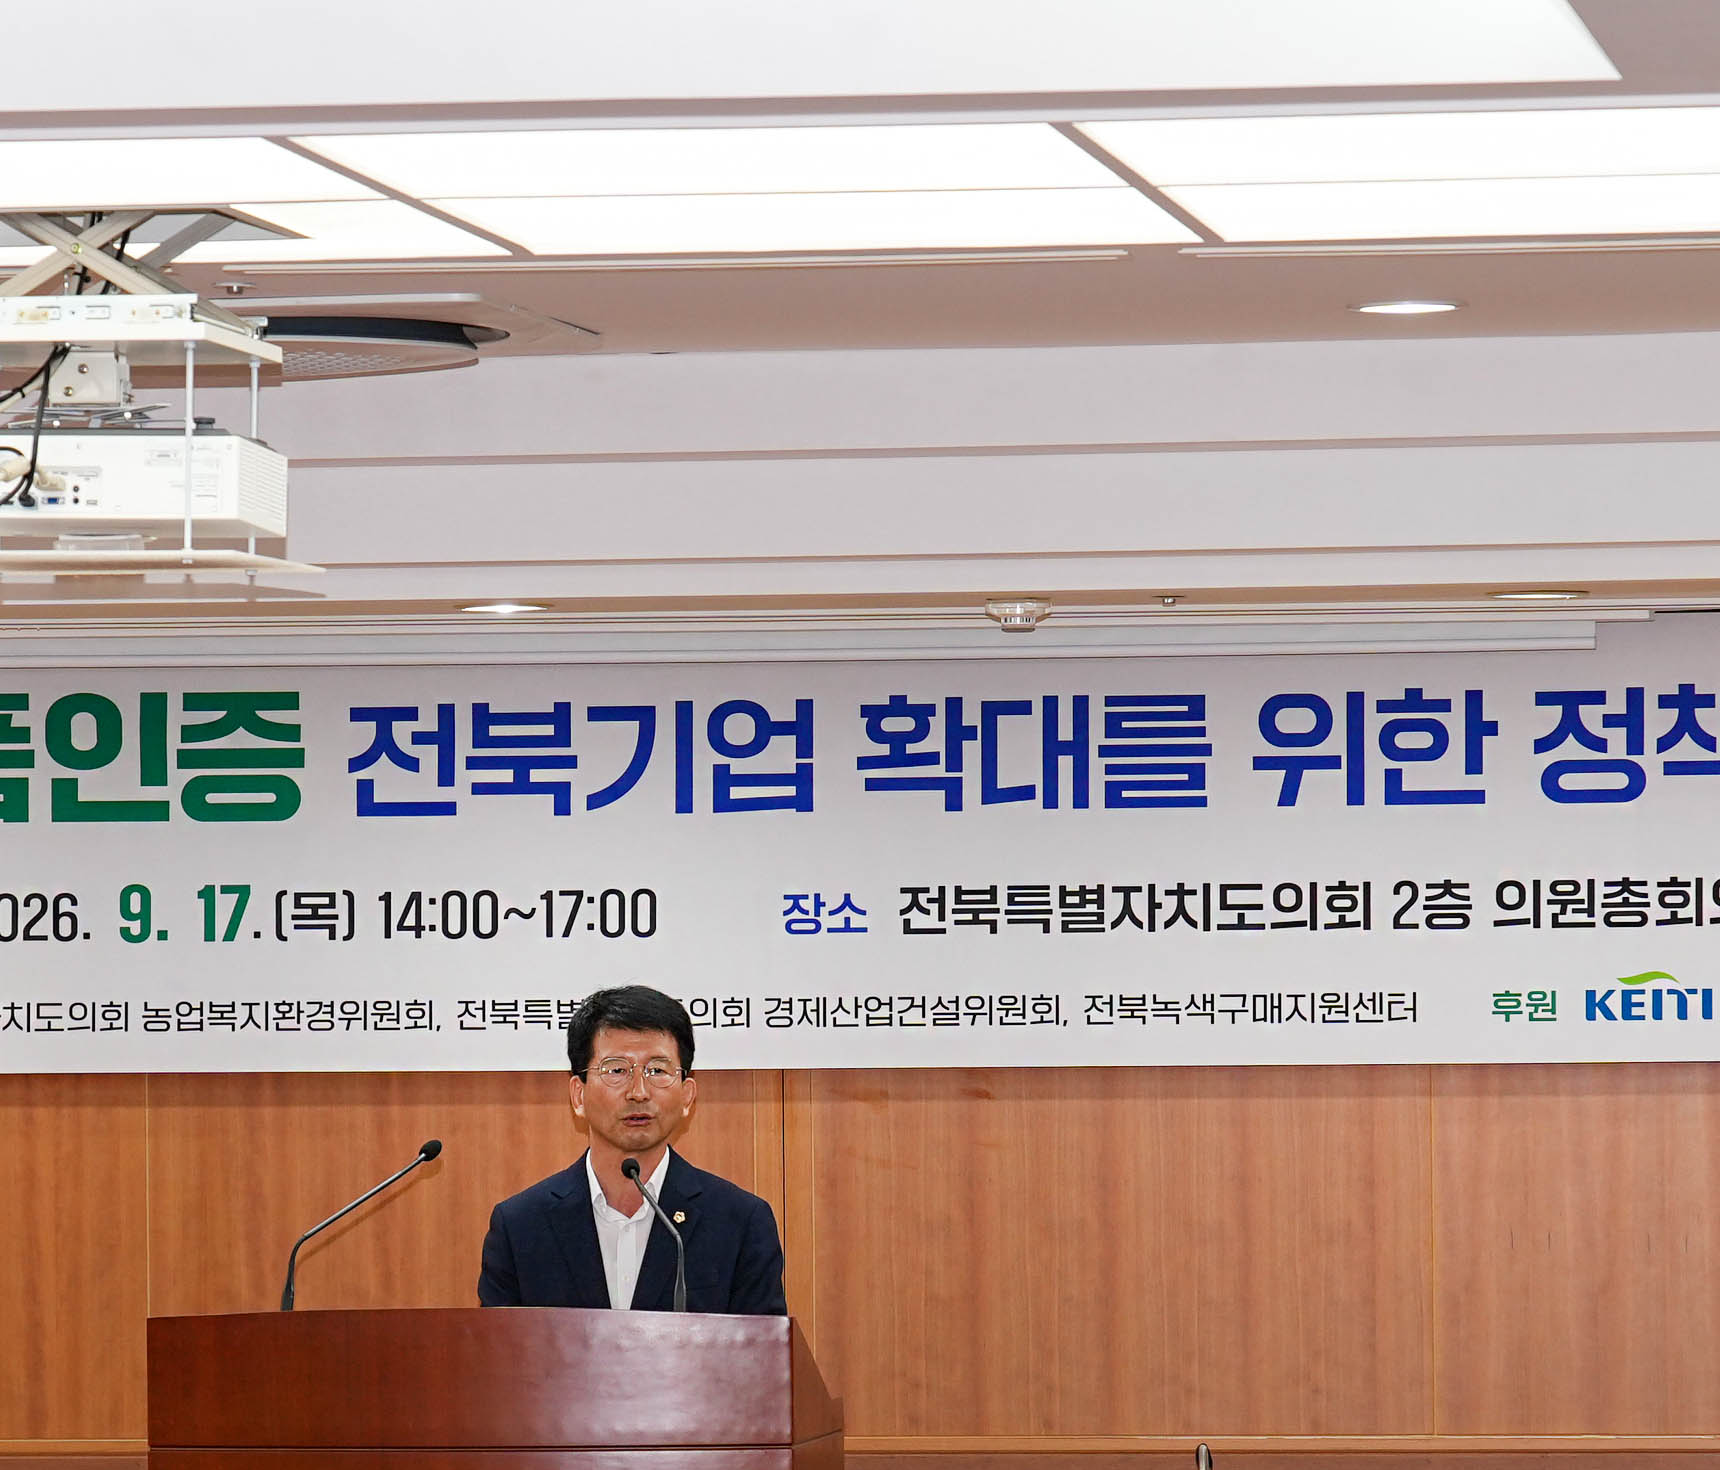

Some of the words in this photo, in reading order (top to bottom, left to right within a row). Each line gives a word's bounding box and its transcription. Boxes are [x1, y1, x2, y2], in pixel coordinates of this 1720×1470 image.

[347, 701, 814, 819] 전북기업
[856, 694, 1213, 814] 확대를
[1252, 687, 1499, 809] 위한
[119, 883, 169, 944] 9.
[377, 888, 657, 940] 14:00~17:00
[782, 892, 869, 935] 장소
[898, 880, 1372, 935] 전북특별자치도의회
[1392, 878, 1473, 930] 2층
[141, 998, 441, 1033] 농업복지환경위원회,
[456, 996, 751, 1031] 전북특별의회
[764, 993, 1068, 1029] 경제산업건설위원회,
[1083, 991, 1417, 1026] 전북녹색구매지원센터
[1491, 989, 1558, 1023] 후원
[1584, 987, 1713, 1022] KEITI
